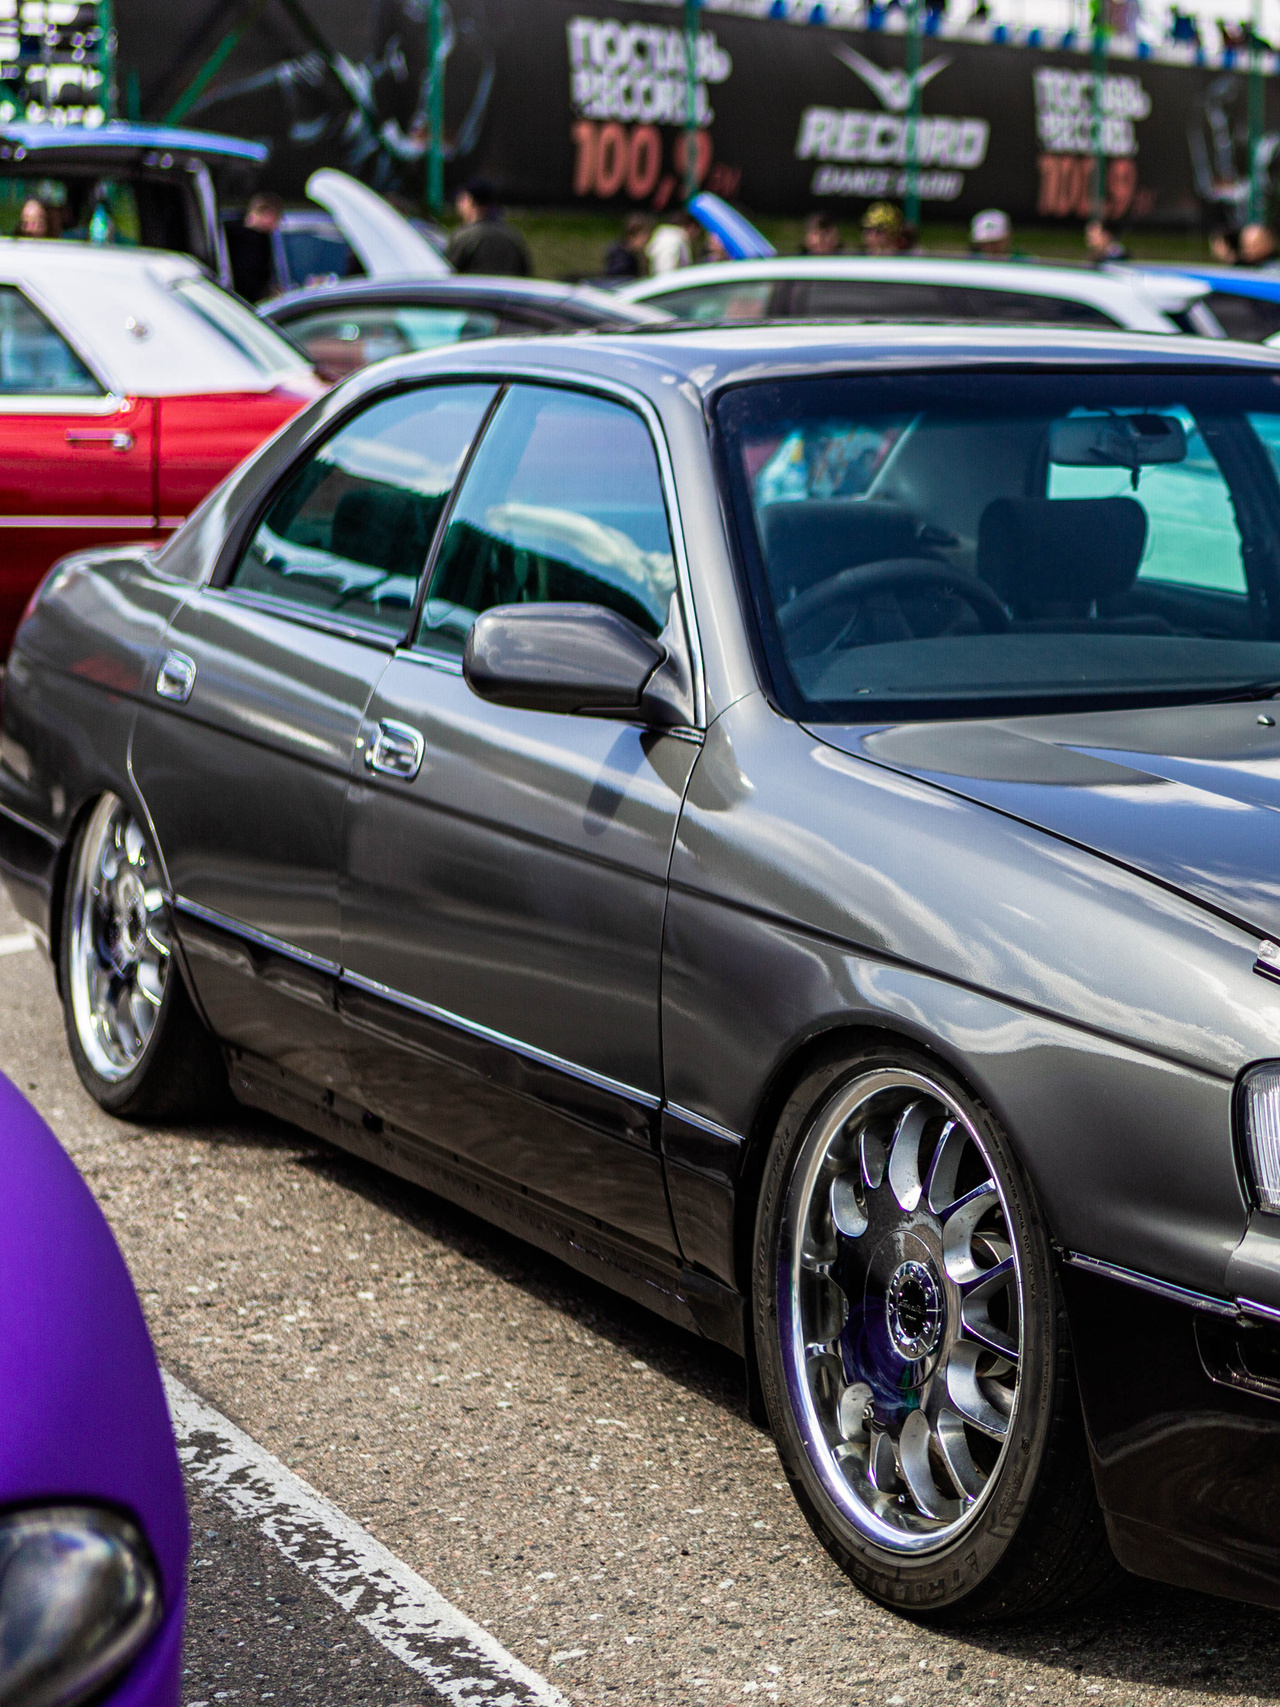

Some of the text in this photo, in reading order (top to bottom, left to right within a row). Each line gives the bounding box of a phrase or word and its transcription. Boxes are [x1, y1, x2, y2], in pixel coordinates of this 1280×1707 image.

[797, 106, 990, 168] RECORD
[1023, 1235, 1031, 1255] DOT
[816, 1522, 965, 1602] TRIANGLE
